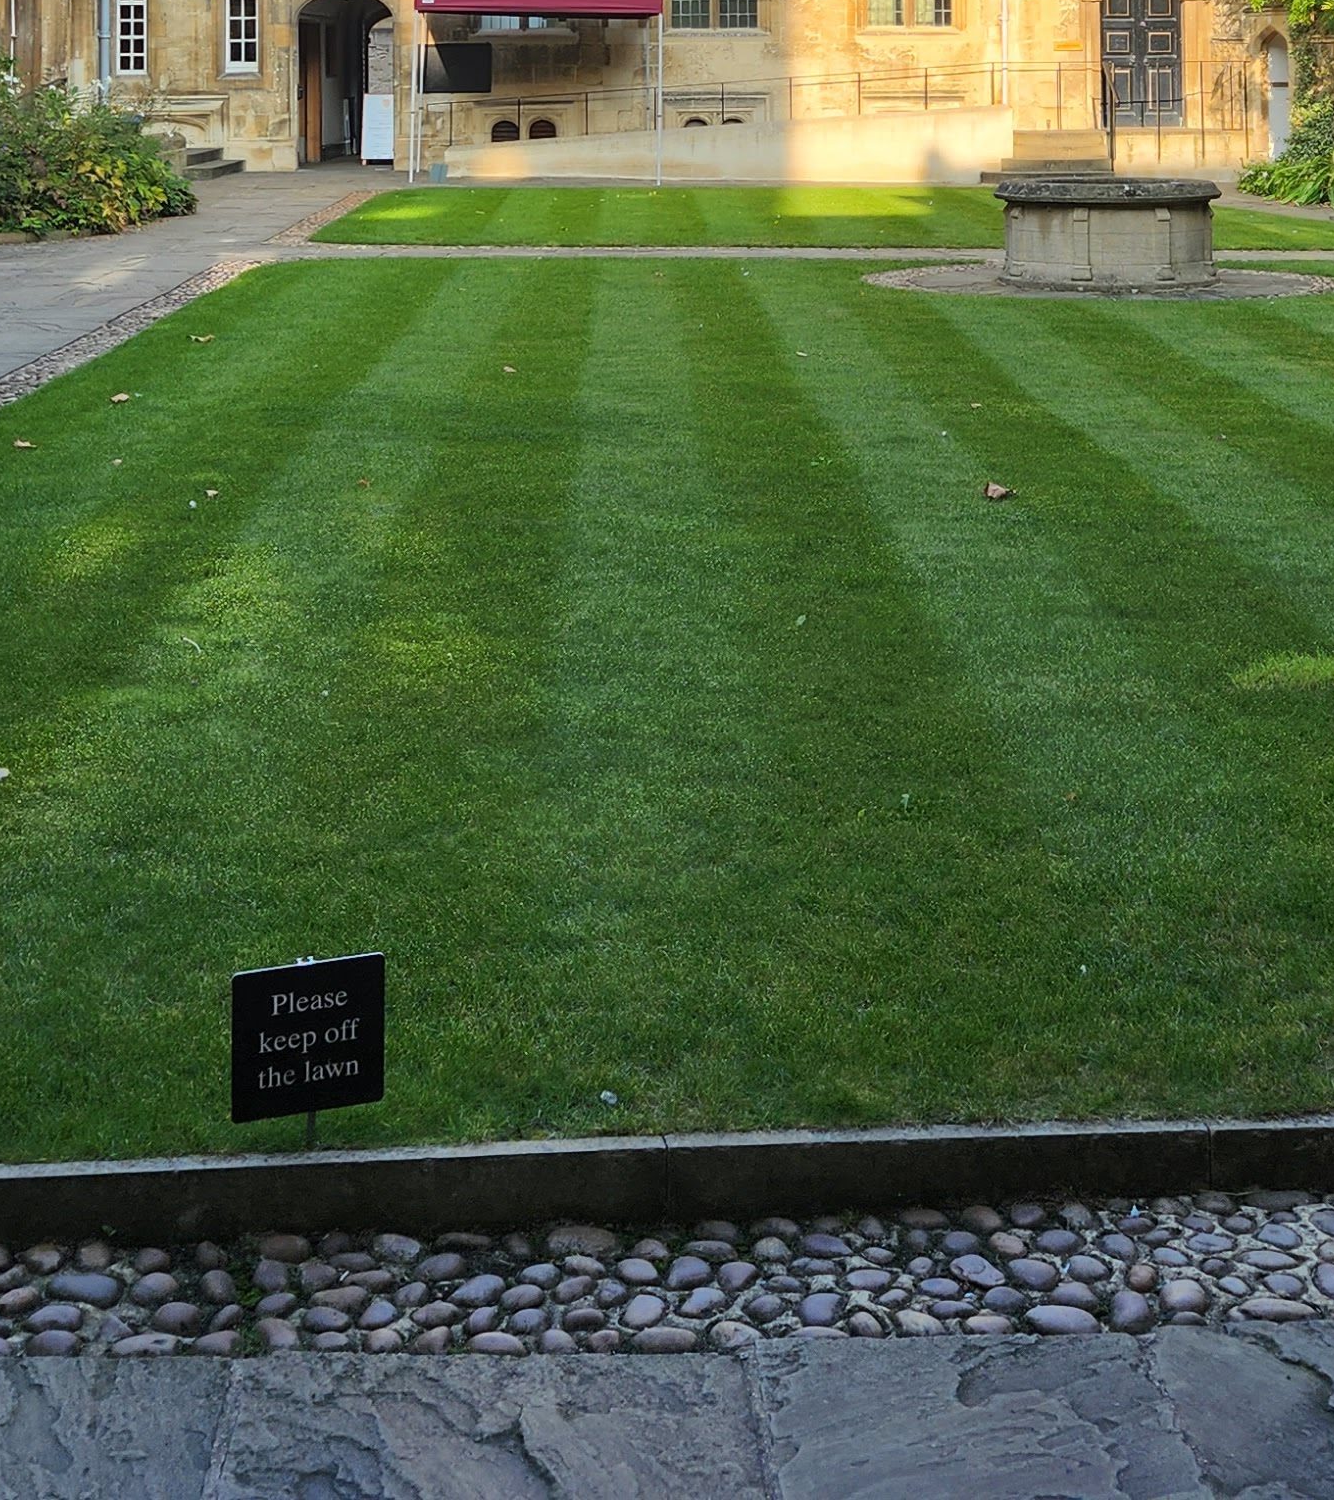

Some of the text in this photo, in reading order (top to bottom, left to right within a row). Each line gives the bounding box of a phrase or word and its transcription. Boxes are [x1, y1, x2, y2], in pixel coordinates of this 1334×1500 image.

[271, 990, 348, 1016] Please
[258, 1017, 360, 1055] keep off
[258, 1059, 359, 1090] the lawn
